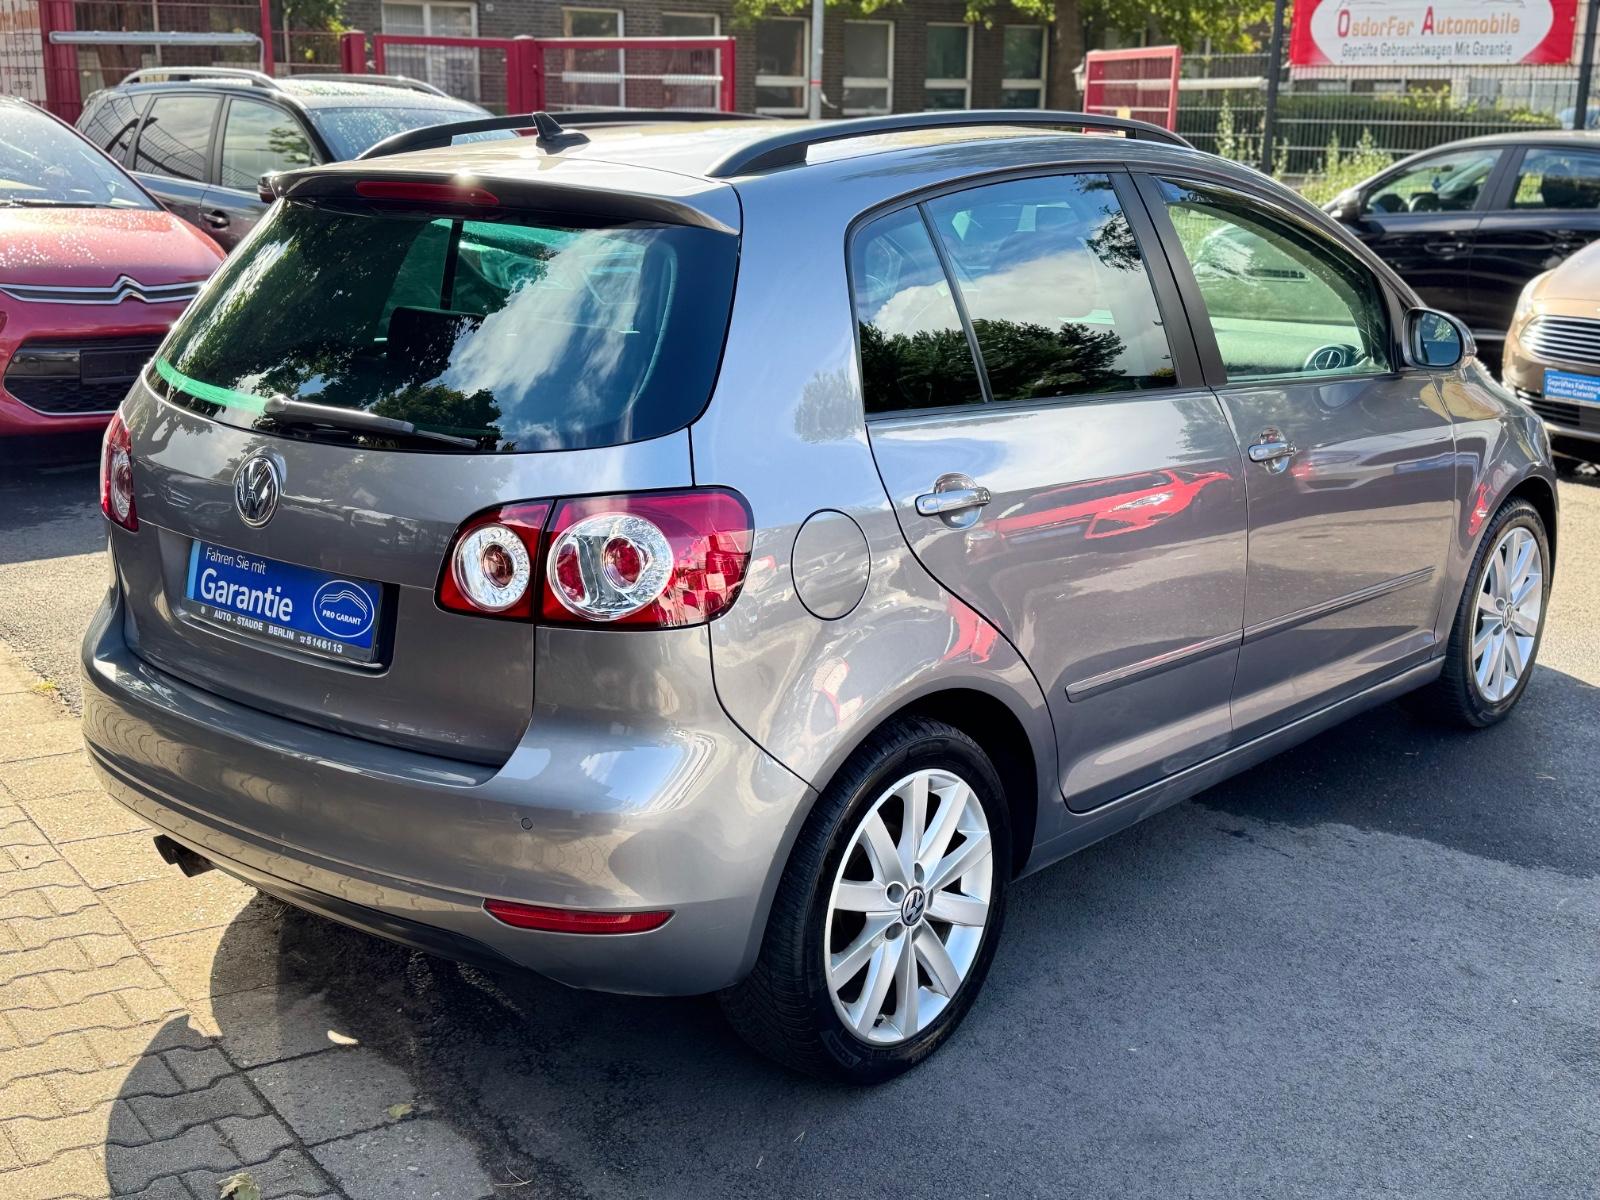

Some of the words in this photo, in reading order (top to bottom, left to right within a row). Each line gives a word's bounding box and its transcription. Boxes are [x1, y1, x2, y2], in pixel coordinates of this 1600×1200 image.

[1421, 6, 1521, 36] Automobile
[1342, 43, 1379, 60] Geprüfte
[1380, 41, 1452, 60] Gebrauchtwagen
[1455, 41, 1471, 56] Mit
[1473, 41, 1513, 56] Garantie
[1547, 385, 1572, 396] Premium
[1573, 389, 1598, 400] Garantie
[205, 547, 234, 567] Fahren
[236, 555, 250, 570] Sie
[251, 561, 267, 576] mit
[200, 567, 294, 622] Garantie
[213, 609, 232, 623] AUTO
[236, 616, 264, 632] STAUDE
[268, 624, 295, 641] BERLIN
[322, 609, 335, 621] PRO
[335, 611, 362, 626] GARANT
